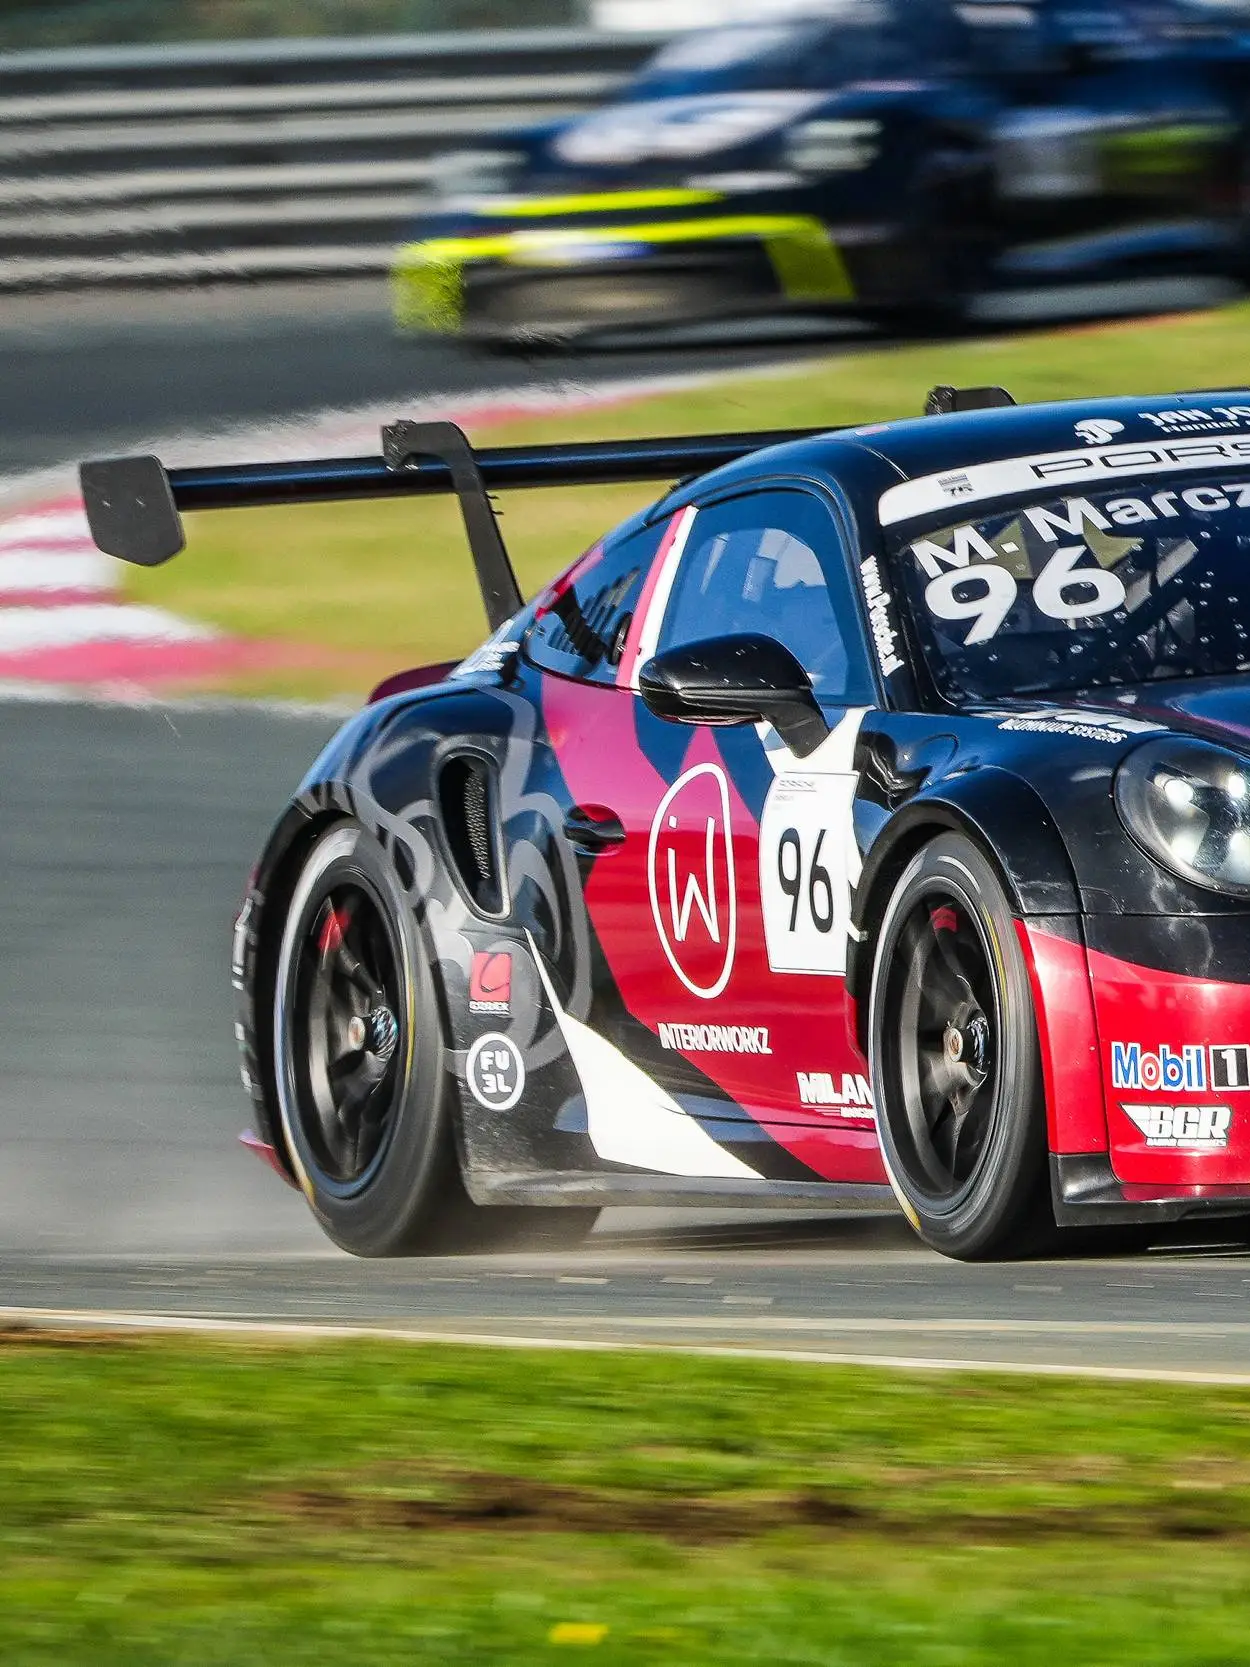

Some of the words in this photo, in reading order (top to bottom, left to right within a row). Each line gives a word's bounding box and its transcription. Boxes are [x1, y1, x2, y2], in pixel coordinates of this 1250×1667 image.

[1138, 408, 1211, 426] JAN
[910, 524, 1020, 577] M.
[924, 546, 1126, 646] 96
[778, 827, 834, 934] 96
[479, 1050, 510, 1071] FU
[657, 1023, 773, 1055] INTERIORWORKZ
[1111, 1041, 1207, 1092] Mobil
[1120, 1103, 1232, 1139] BGR
